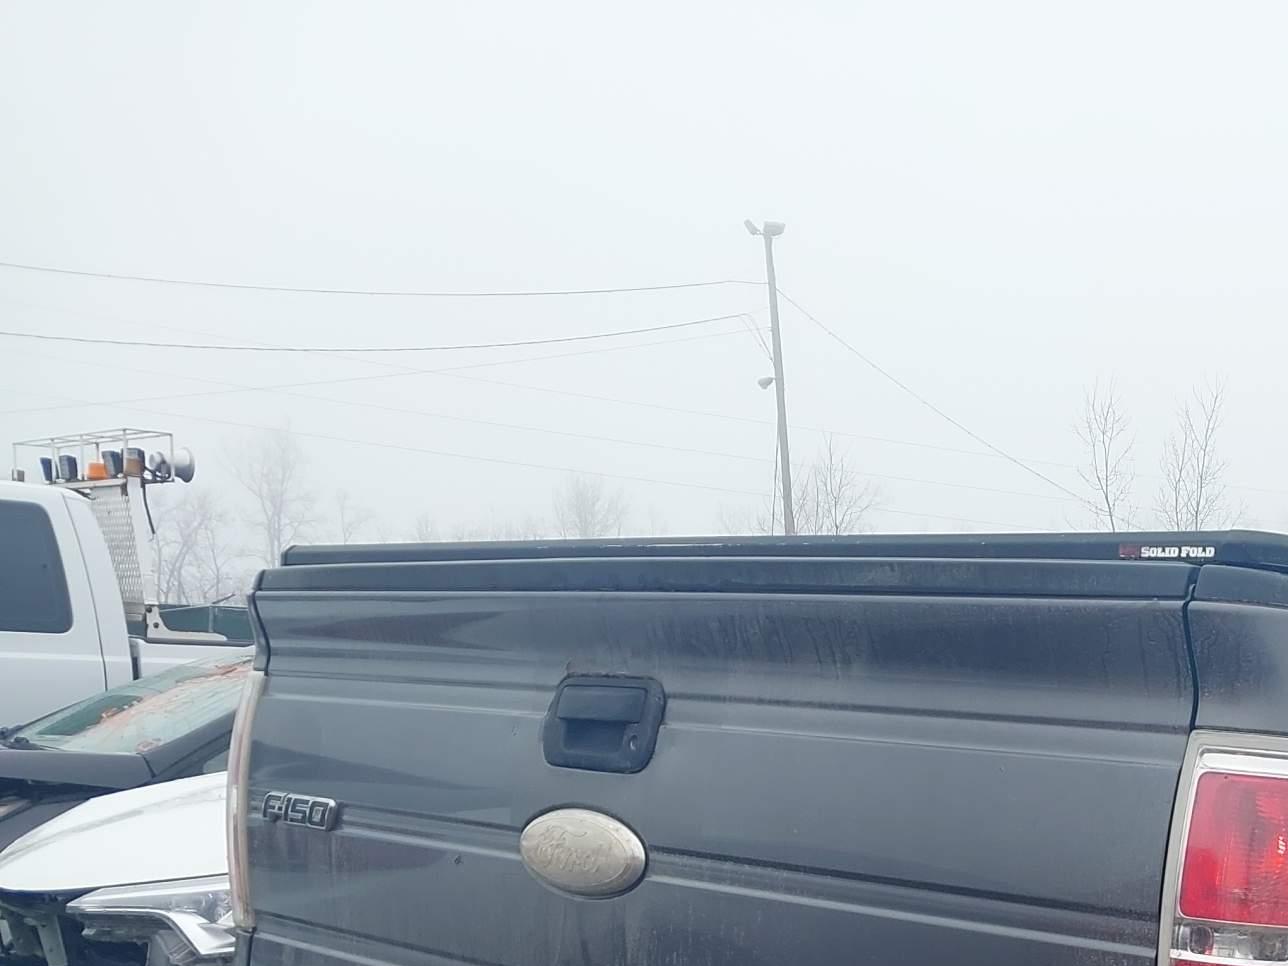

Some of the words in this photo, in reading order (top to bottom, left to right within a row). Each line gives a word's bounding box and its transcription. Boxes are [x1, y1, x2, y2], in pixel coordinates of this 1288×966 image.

[1140, 546, 1179, 558] SOLID
[1180, 546, 1215, 558] FOLD
[536, 824, 613, 873] Ford
